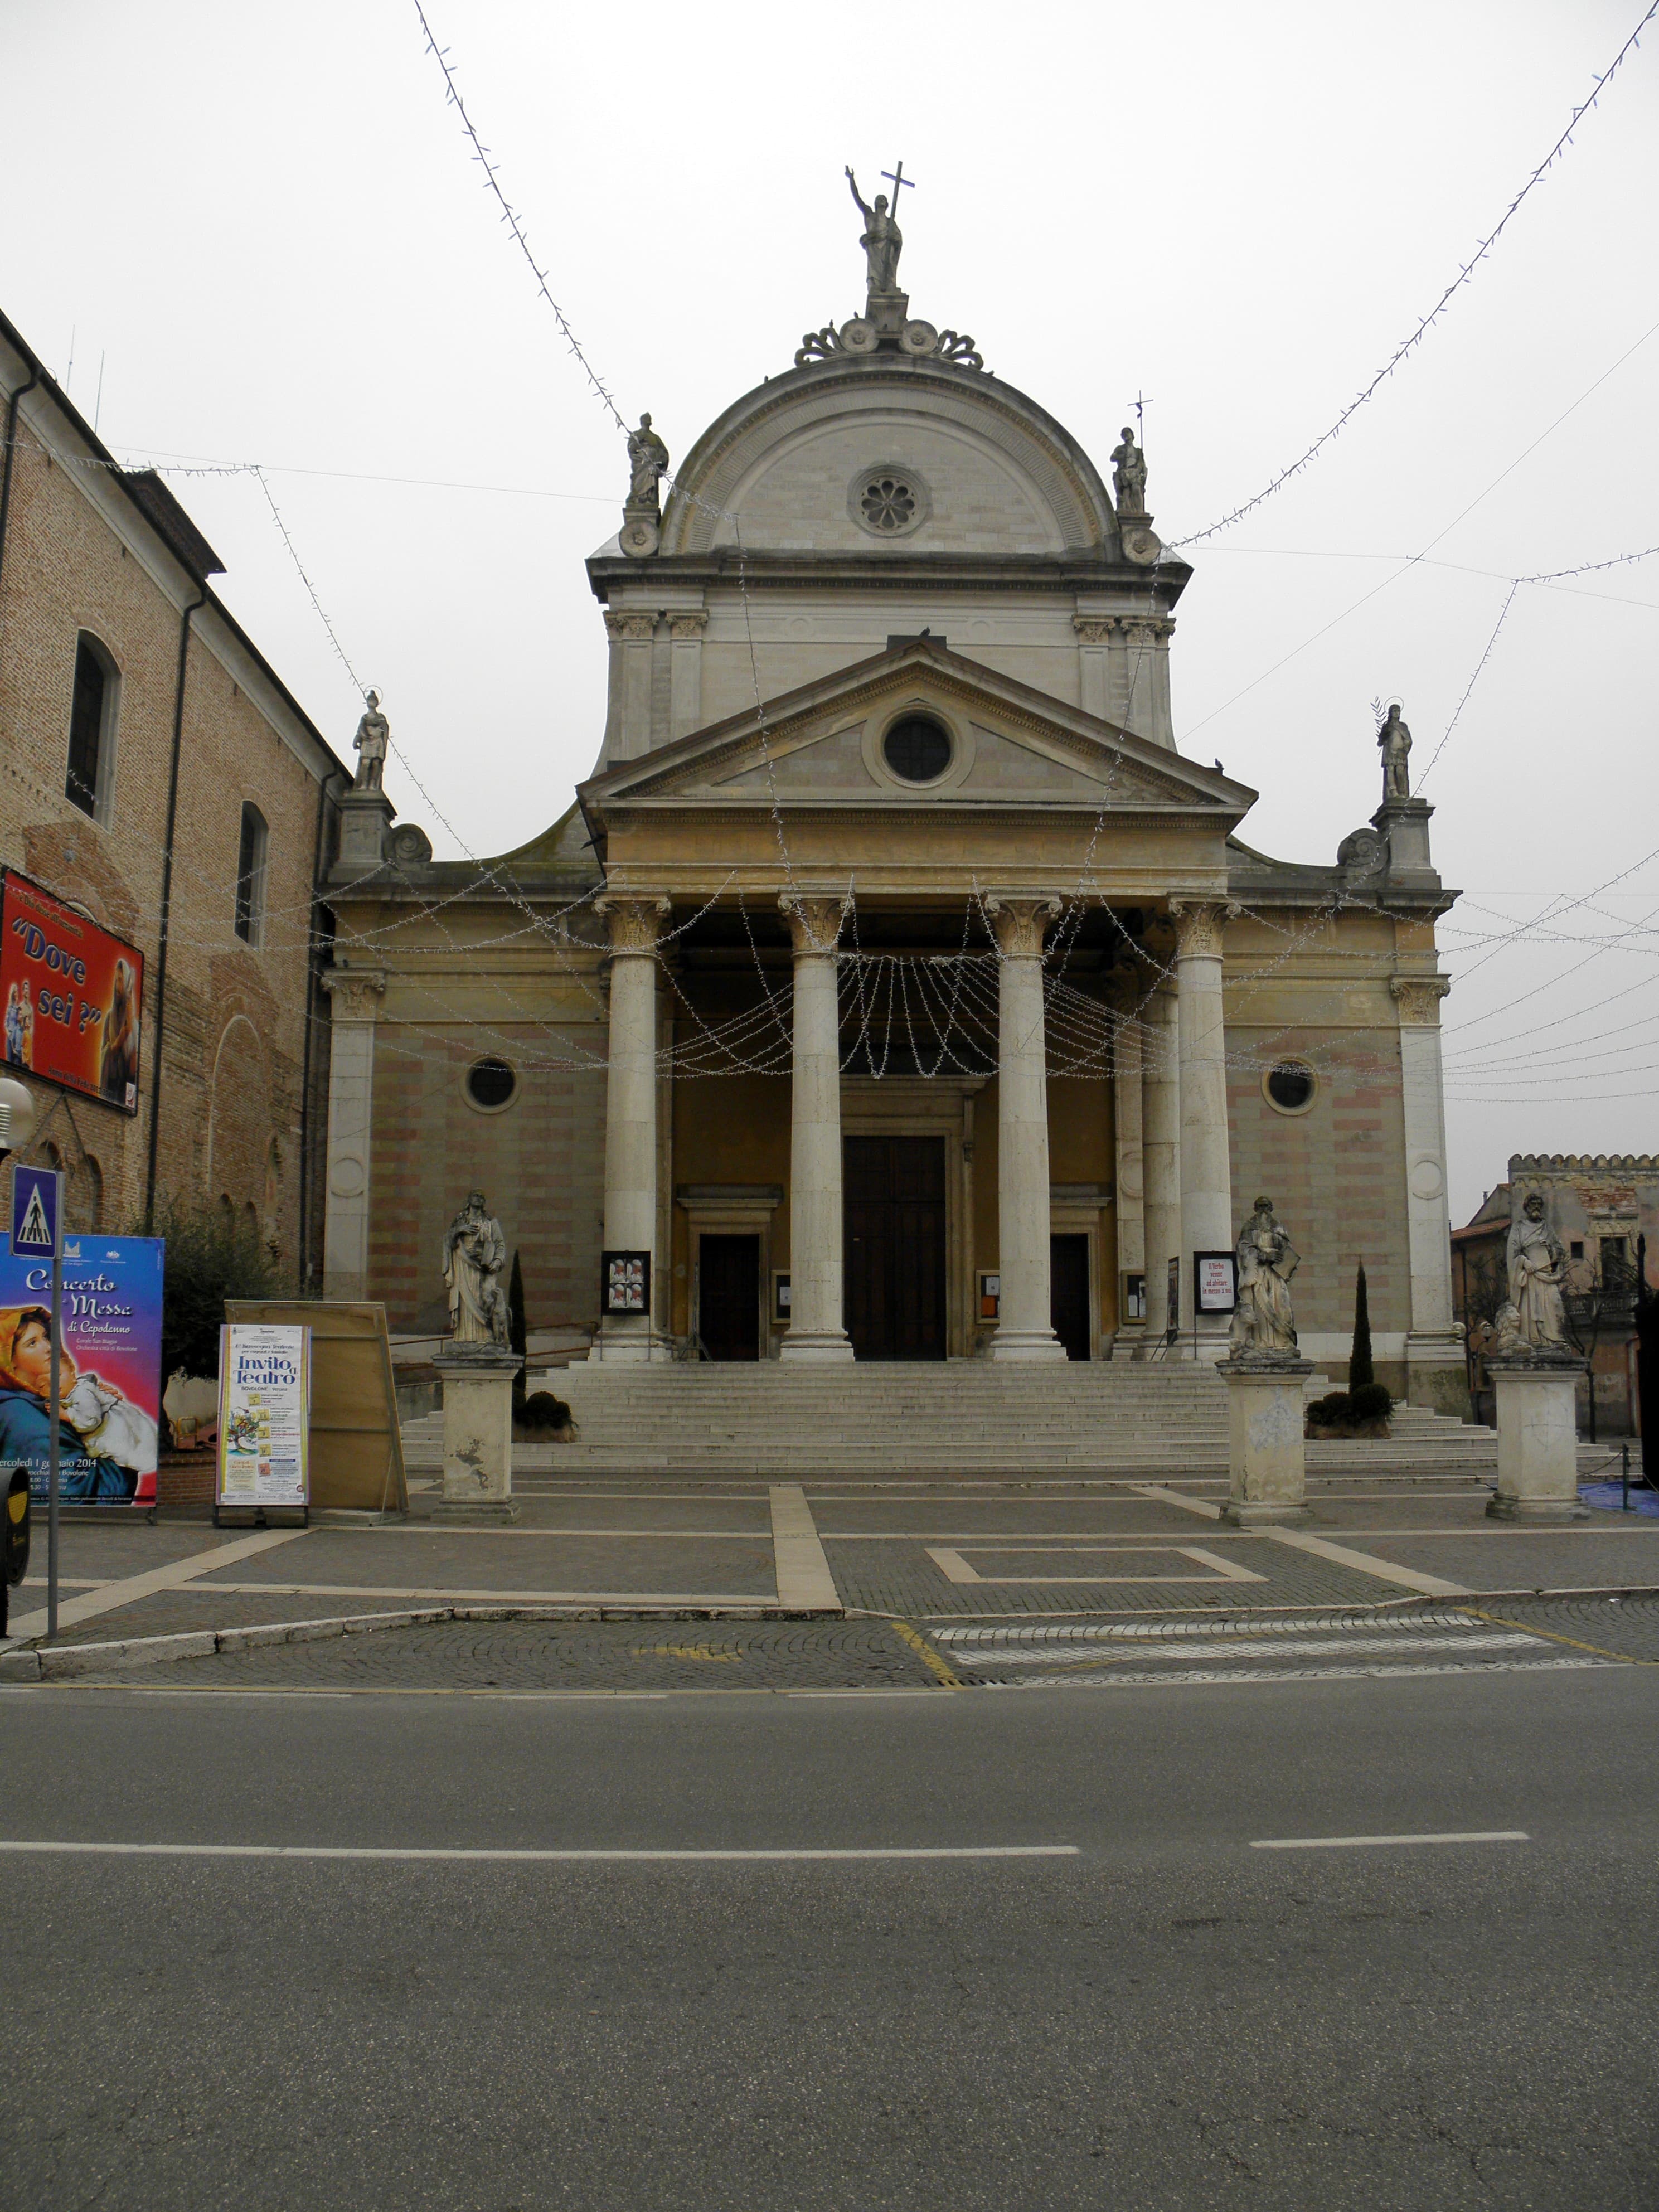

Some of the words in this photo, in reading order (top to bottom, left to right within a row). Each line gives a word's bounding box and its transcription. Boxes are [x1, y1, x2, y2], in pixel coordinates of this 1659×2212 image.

[38, 989, 73, 1026] sei
[71, 1293, 132, 1320] Messa
[67, 1321, 77, 1333] di
[80, 1321, 130, 1336] Capodanno
[237, 1355, 292, 1370] Invito
[233, 1370, 295, 1385] Teatro
[0, 1458, 32, 1467] ercoledì
[41, 1459, 74, 1469] genaio
[77, 1458, 96, 1467] 2014
